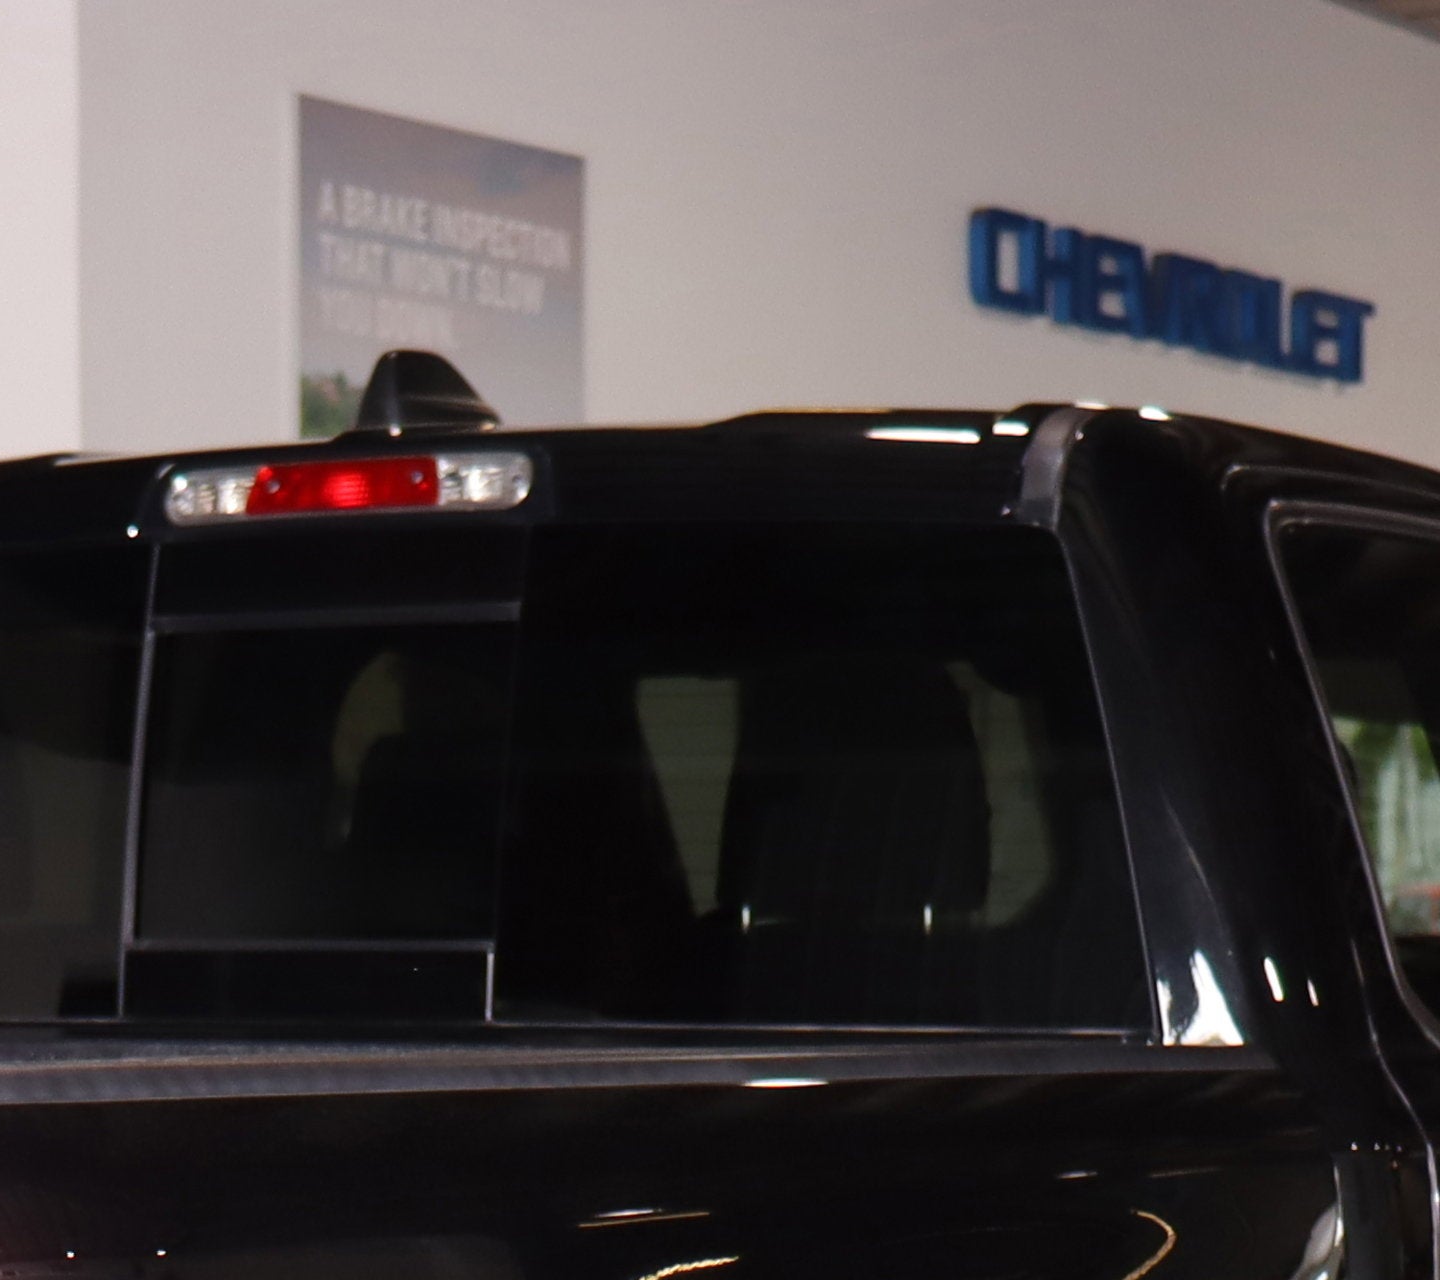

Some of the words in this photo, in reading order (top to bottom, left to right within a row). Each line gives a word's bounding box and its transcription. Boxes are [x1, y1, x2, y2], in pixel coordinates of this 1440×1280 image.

[318, 181, 337, 222] A
[341, 184, 429, 242] BRAKE
[431, 203, 572, 271] INSPECTION
[474, 263, 547, 318] SLOW
[968, 206, 1375, 383] CHEVROLET
